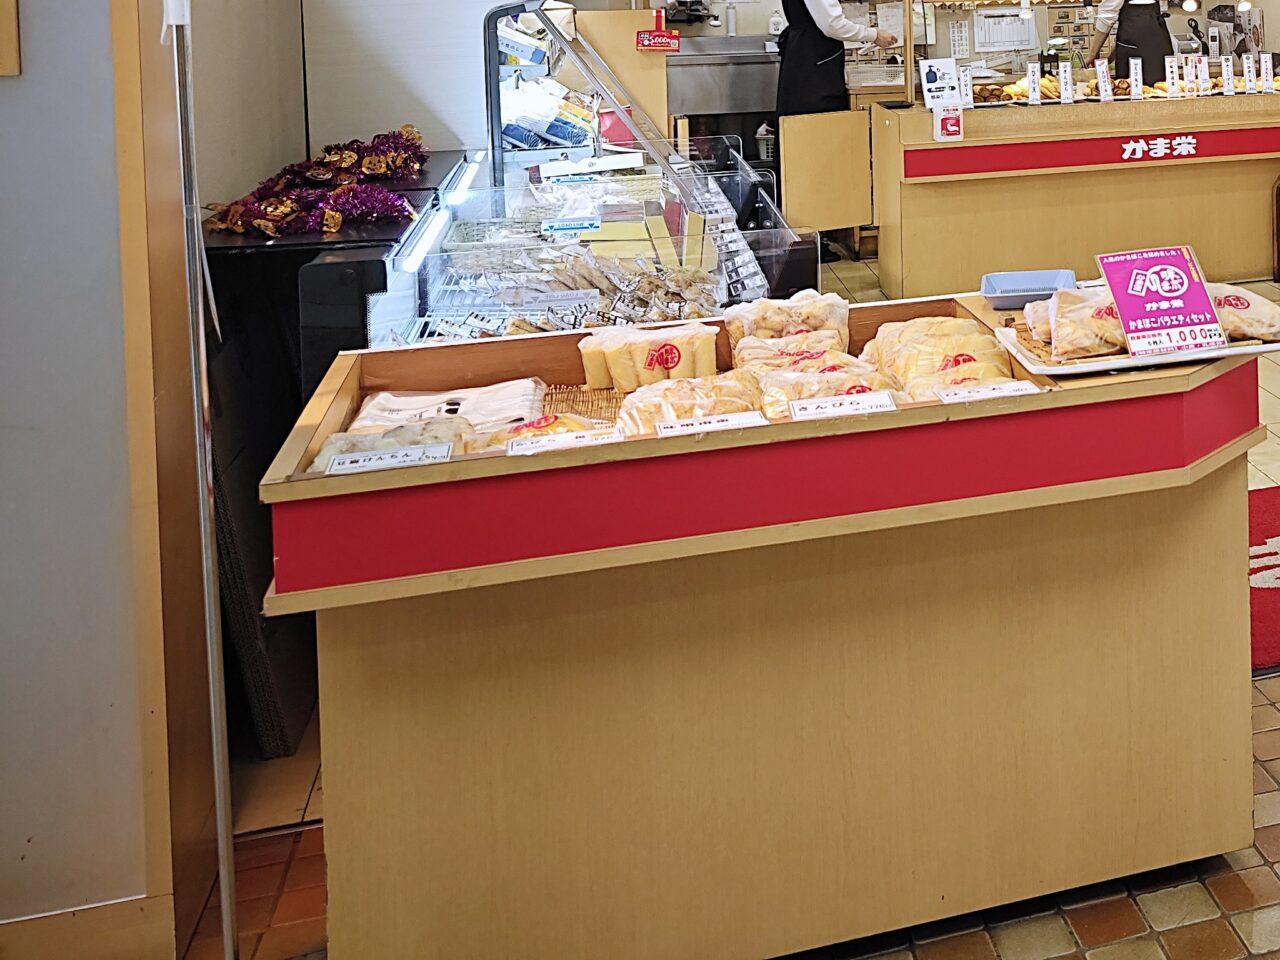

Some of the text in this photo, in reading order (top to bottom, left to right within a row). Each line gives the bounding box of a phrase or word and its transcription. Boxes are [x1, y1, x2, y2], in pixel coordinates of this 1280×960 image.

[1121, 135, 1197, 160] かま栄
[1144, 299, 1185, 312] かま栄
